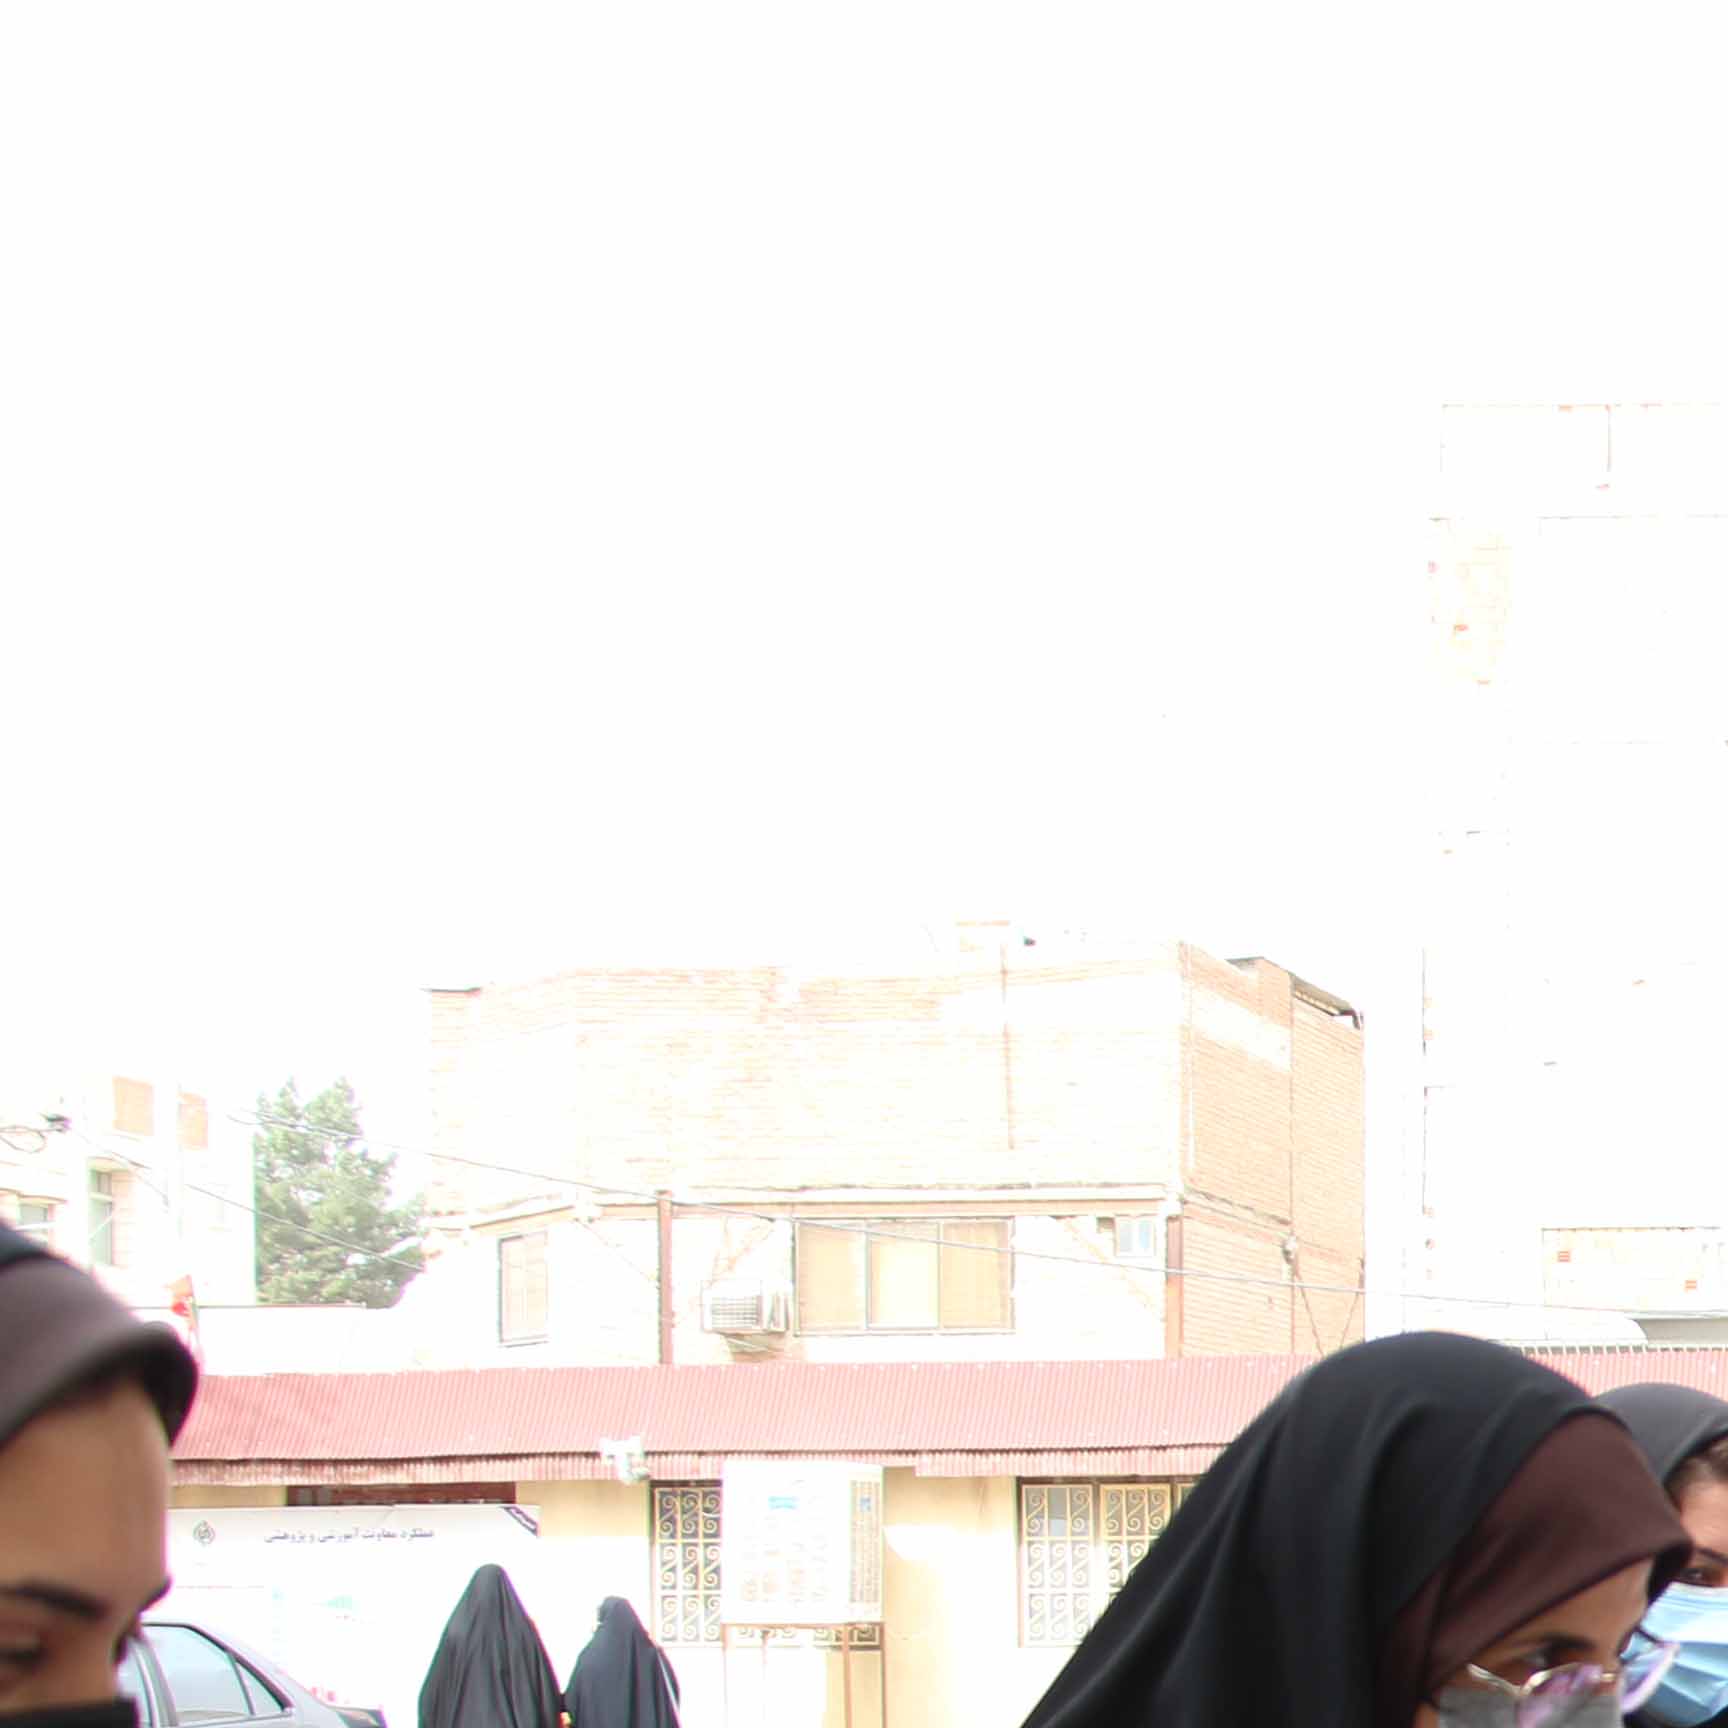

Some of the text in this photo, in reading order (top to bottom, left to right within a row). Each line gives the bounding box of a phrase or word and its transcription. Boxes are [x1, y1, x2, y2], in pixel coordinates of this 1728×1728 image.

[263, 1527, 307, 1545] پژوهشی
[317, 1524, 360, 1545] آموزشی
[360, 1527, 397, 1543] معاونت
[399, 1526, 435, 1543] عملکرد
